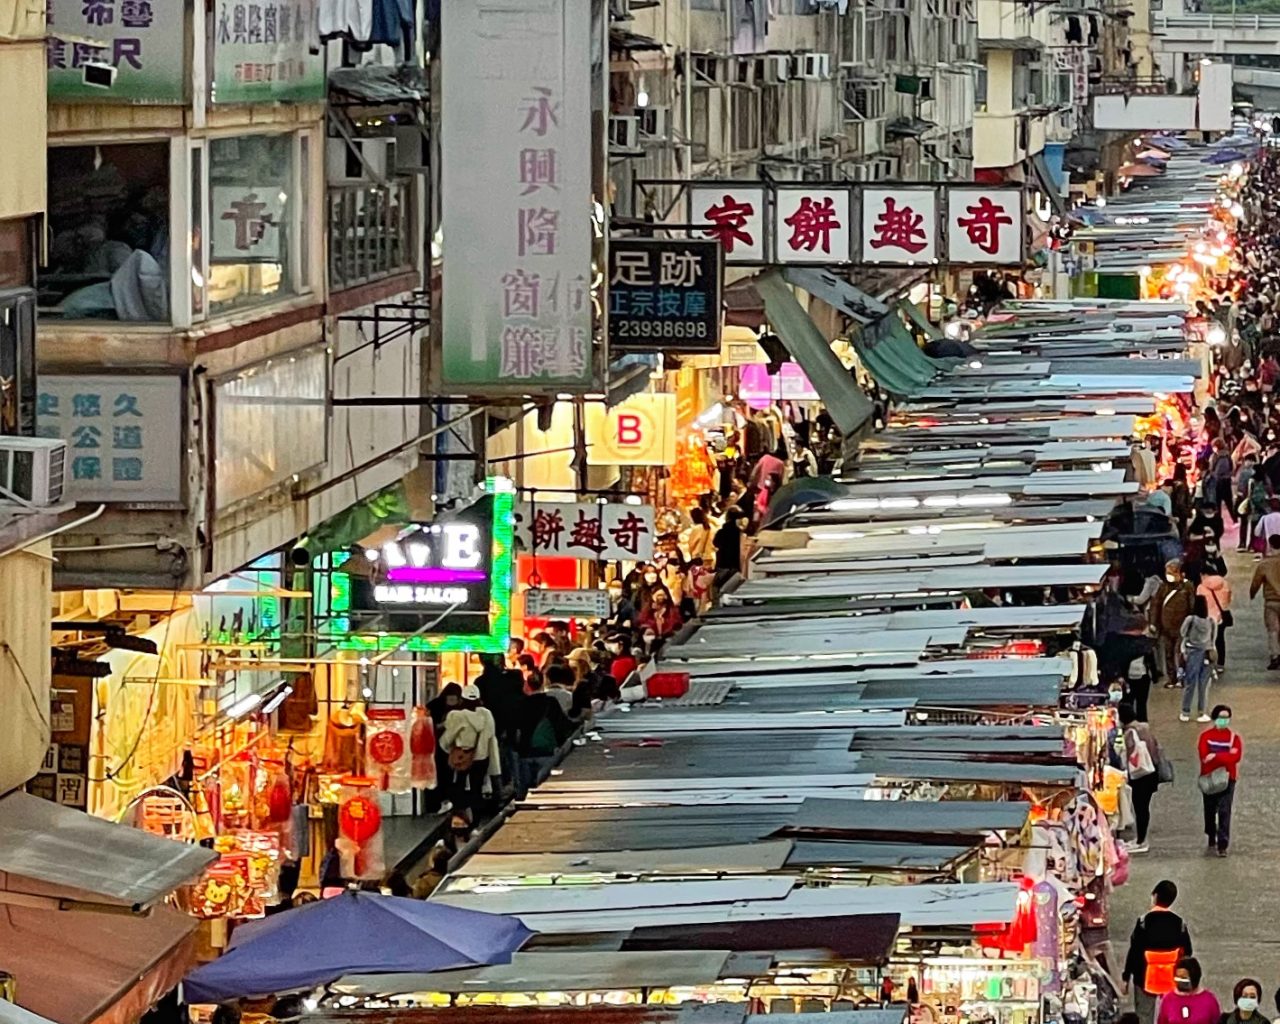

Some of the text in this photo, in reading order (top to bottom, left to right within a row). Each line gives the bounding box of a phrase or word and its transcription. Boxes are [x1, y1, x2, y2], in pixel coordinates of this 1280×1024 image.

[518, 86, 561, 256] 永興隆
[611, 251, 703, 287] 足跡
[610, 290, 706, 316] 正宗按摩
[617, 414, 642, 444] B
[374, 586, 468, 603] HAIR SALON
